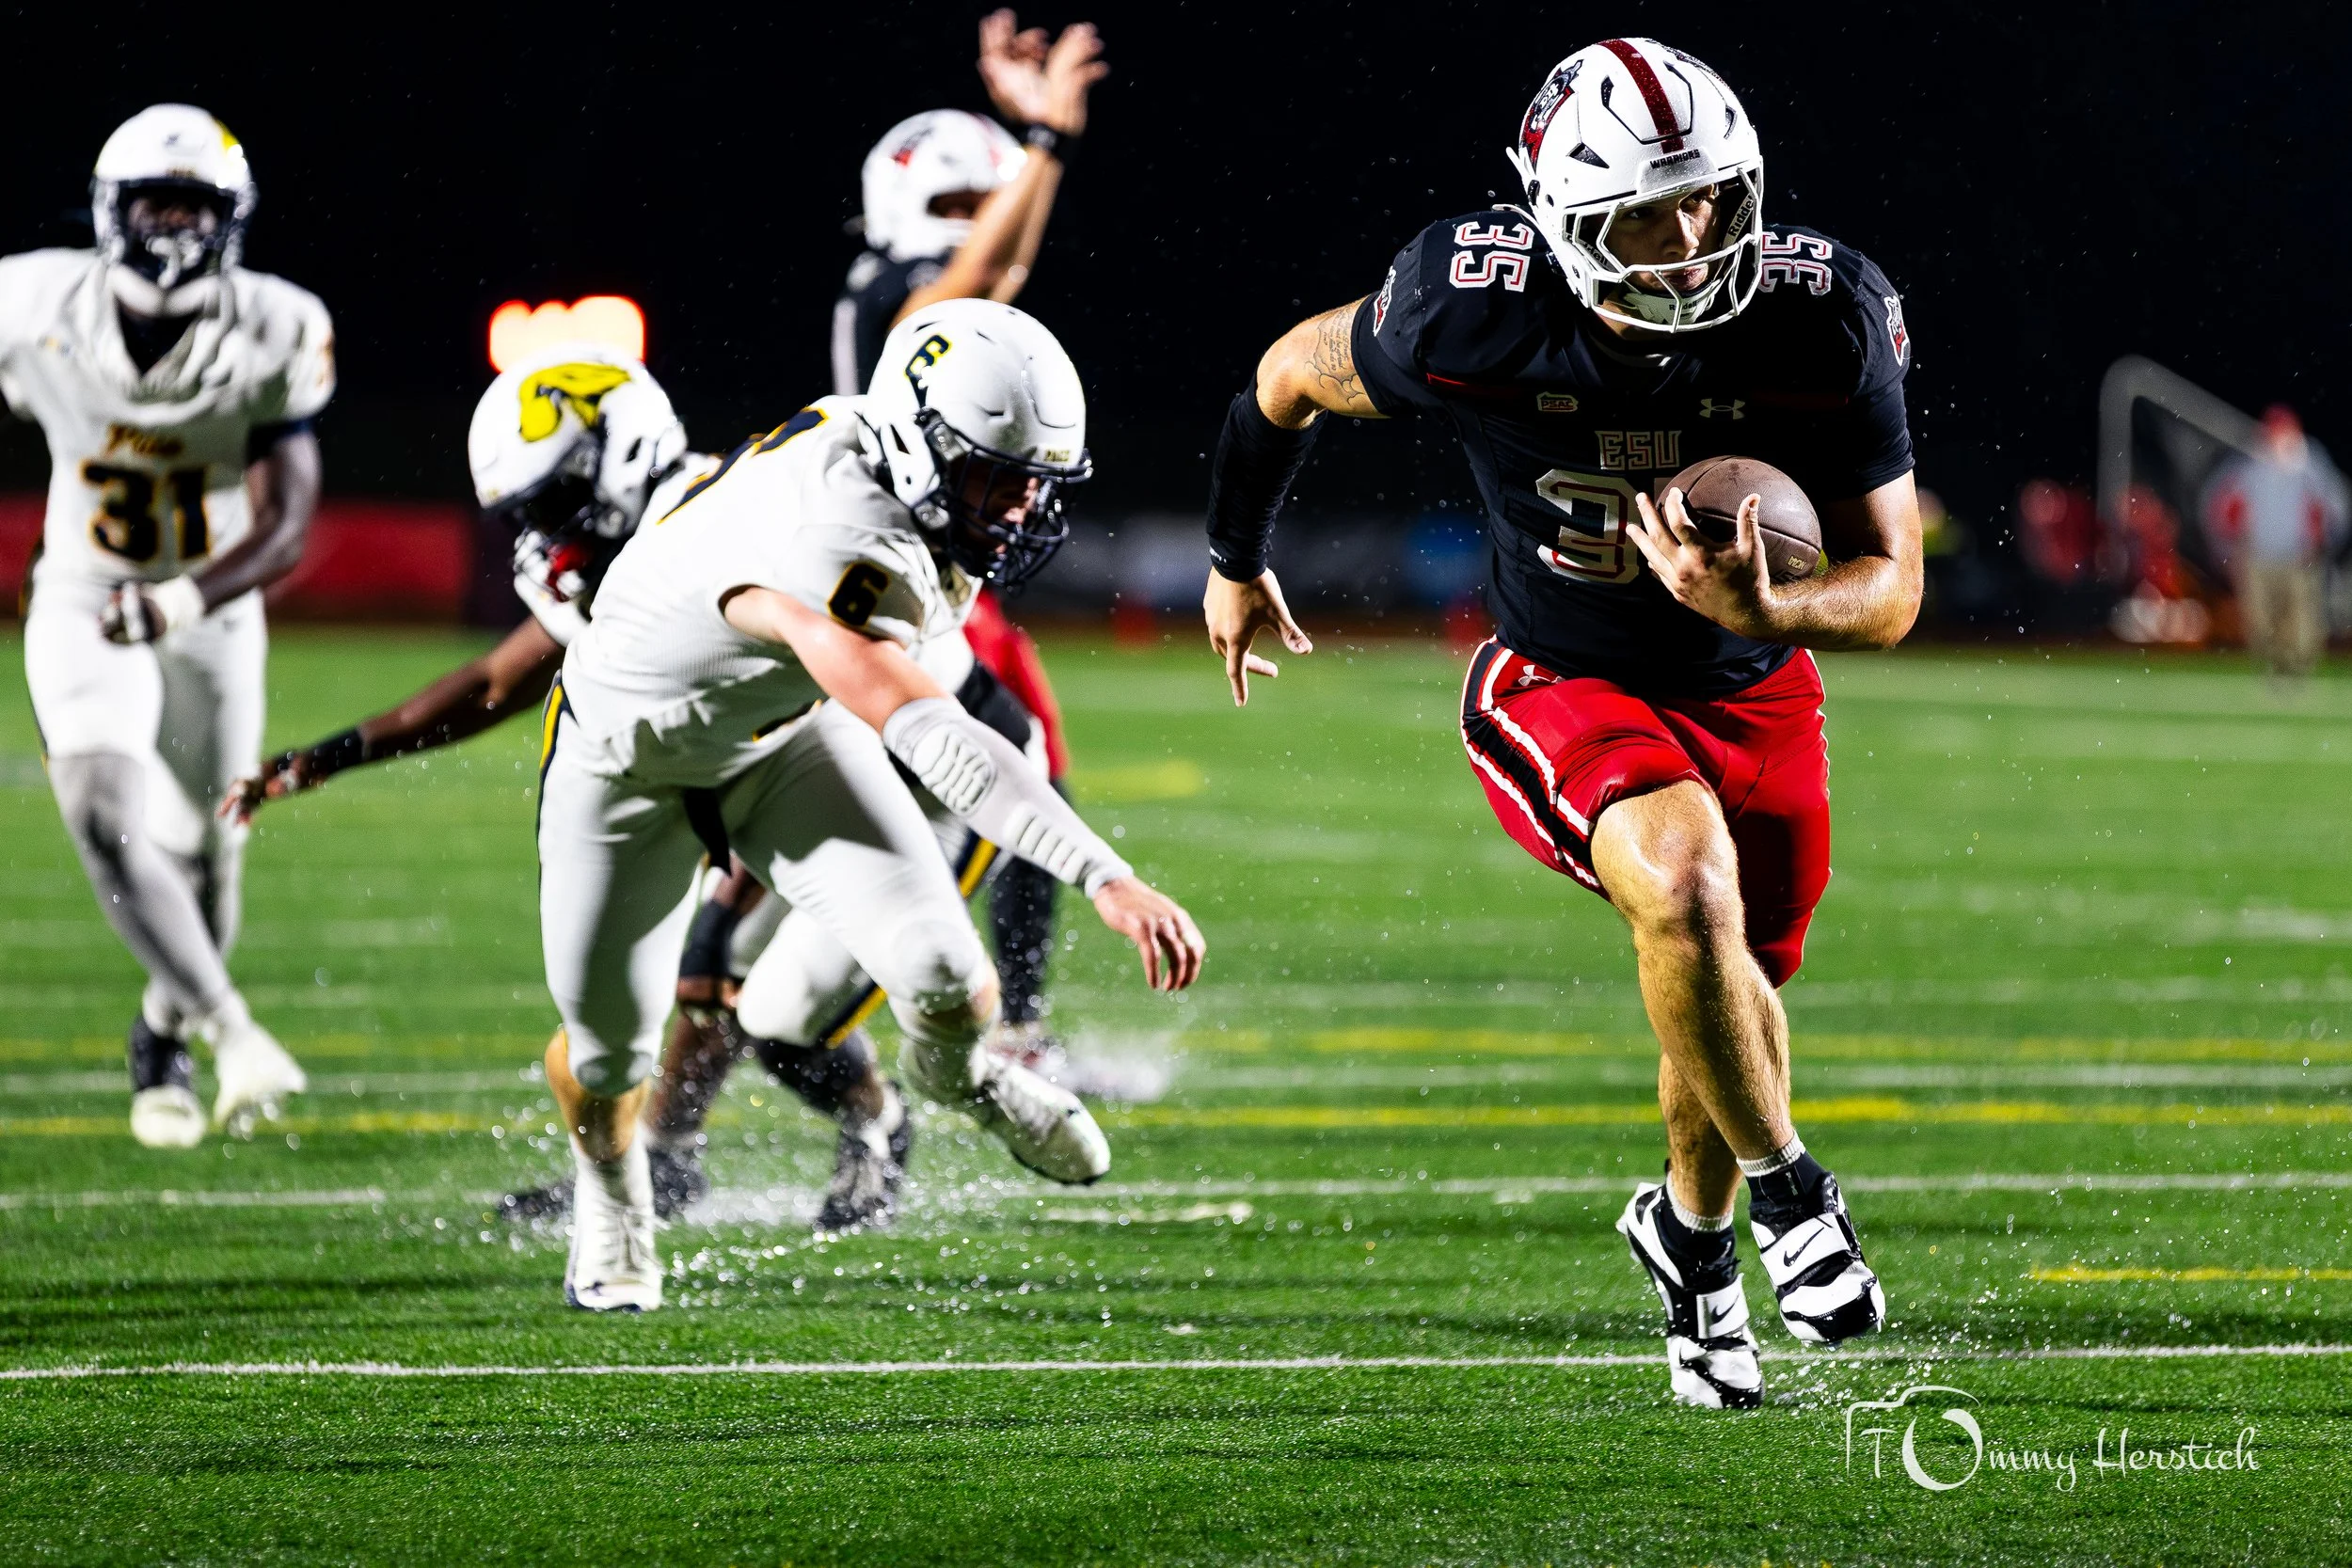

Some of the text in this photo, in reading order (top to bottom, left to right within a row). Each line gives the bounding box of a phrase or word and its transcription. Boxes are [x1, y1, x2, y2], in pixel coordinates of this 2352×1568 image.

[1649, 149, 1700, 169] WARRIORS
[1728, 195, 1754, 236] Riddel
[1450, 221, 1534, 293] 35
[1757, 231, 1832, 295] 35
[1542, 400, 1574, 408] PSAC
[1595, 430, 1682, 470] ESU
[81, 462, 211, 562] 31
[1535, 469, 1673, 584] 3
[828, 561, 889, 627] 6
